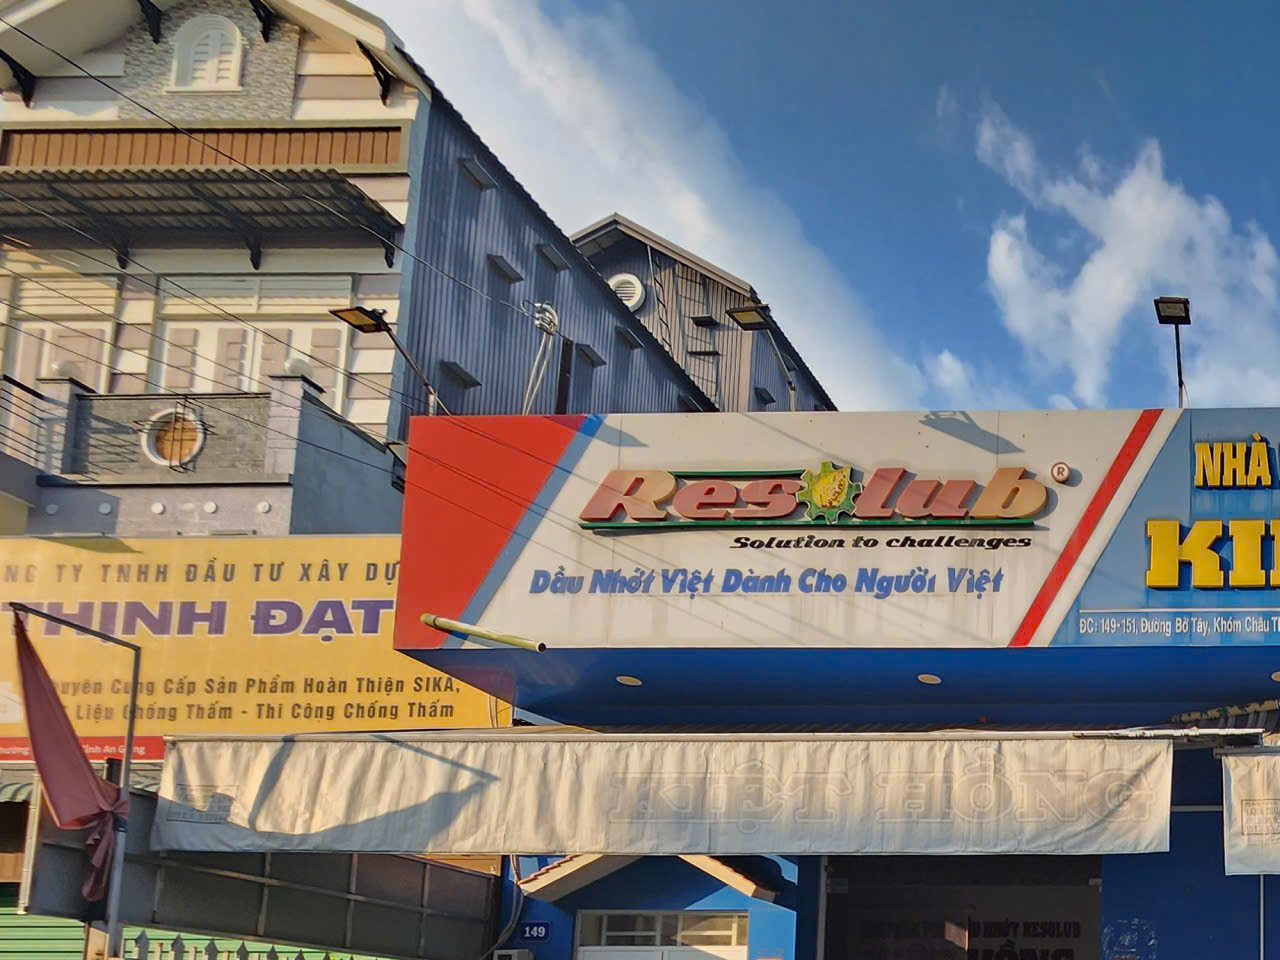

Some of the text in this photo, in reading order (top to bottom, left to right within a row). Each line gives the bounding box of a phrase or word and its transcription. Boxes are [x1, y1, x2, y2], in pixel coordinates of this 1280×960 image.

[1194, 432, 1272, 488] NHÀ
[730, 535, 1032, 550] Solution to challenges
[56, 564, 83, 582] TY
[101, 564, 168, 582] TNHH
[185, 557, 236, 582] ĐẦU
[254, 560, 285, 582] TƯ
[299, 559, 349, 582] XÂY
[529, 565, 1005, 600] Dầu Nhớt Việt Dành Cho Người Việt
[250, 600, 395, 642] ĐẠT
[1101, 616, 1139, 636] 149-151,
[1140, 616, 1171, 637] Đường
[1213, 616, 1242, 633] Khóm
[1244, 616, 1270, 633] Châu
[163, 676, 196, 697] Cấp
[204, 675, 237, 694] Sản
[246, 674, 295, 694] Phẩm
[303, 676, 347, 693] Hoàn
[356, 676, 405, 696] Thiện
[413, 675, 461, 694] SIKA,
[186, 701, 233, 719] Thấm
[256, 703, 282, 719] Thi
[291, 703, 335, 720] Công
[344, 700, 399, 720] Chống
[408, 699, 454, 718] Thấm
[523, 925, 546, 938] 149
